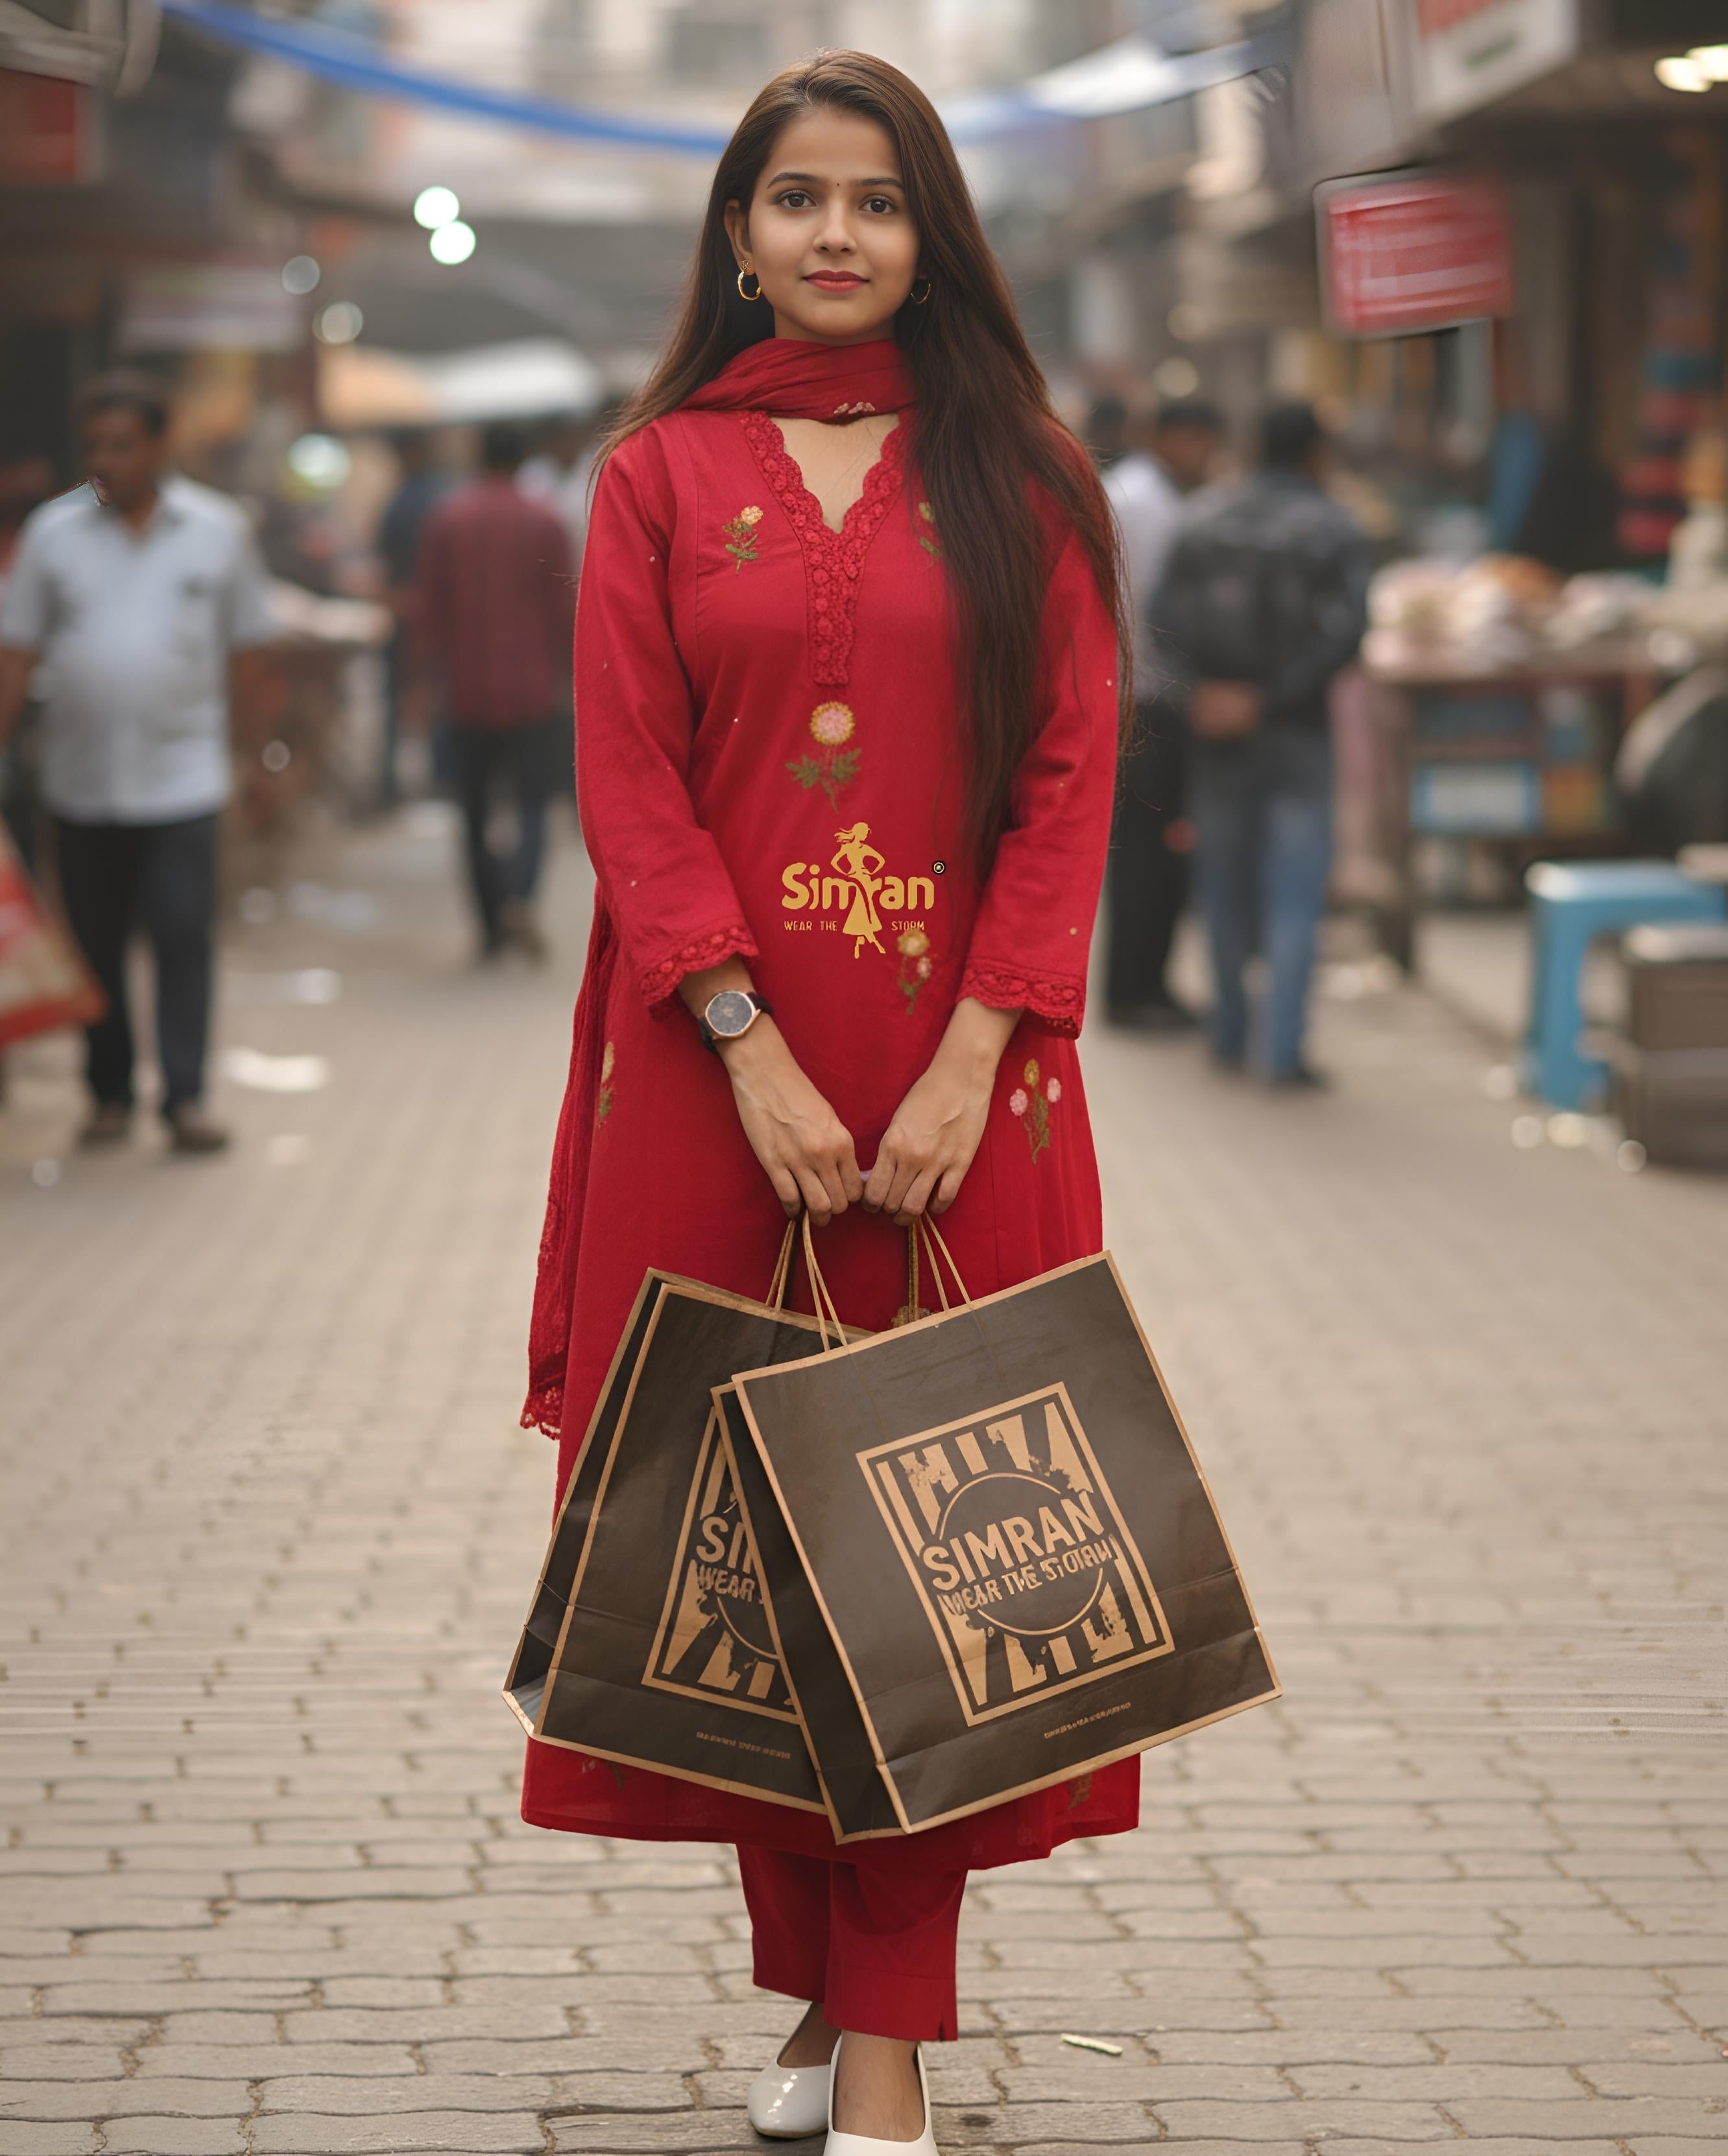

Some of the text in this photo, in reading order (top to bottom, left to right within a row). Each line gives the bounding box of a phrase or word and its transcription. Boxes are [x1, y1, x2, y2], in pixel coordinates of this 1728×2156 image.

[782, 862, 934, 909] Simran
[784, 920, 924, 931] WEAR THE STORM
[923, 1491, 1104, 1591] SIMRAN
[699, 1564, 756, 1602] WEAR
[937, 1579, 1003, 1616] WEAR
